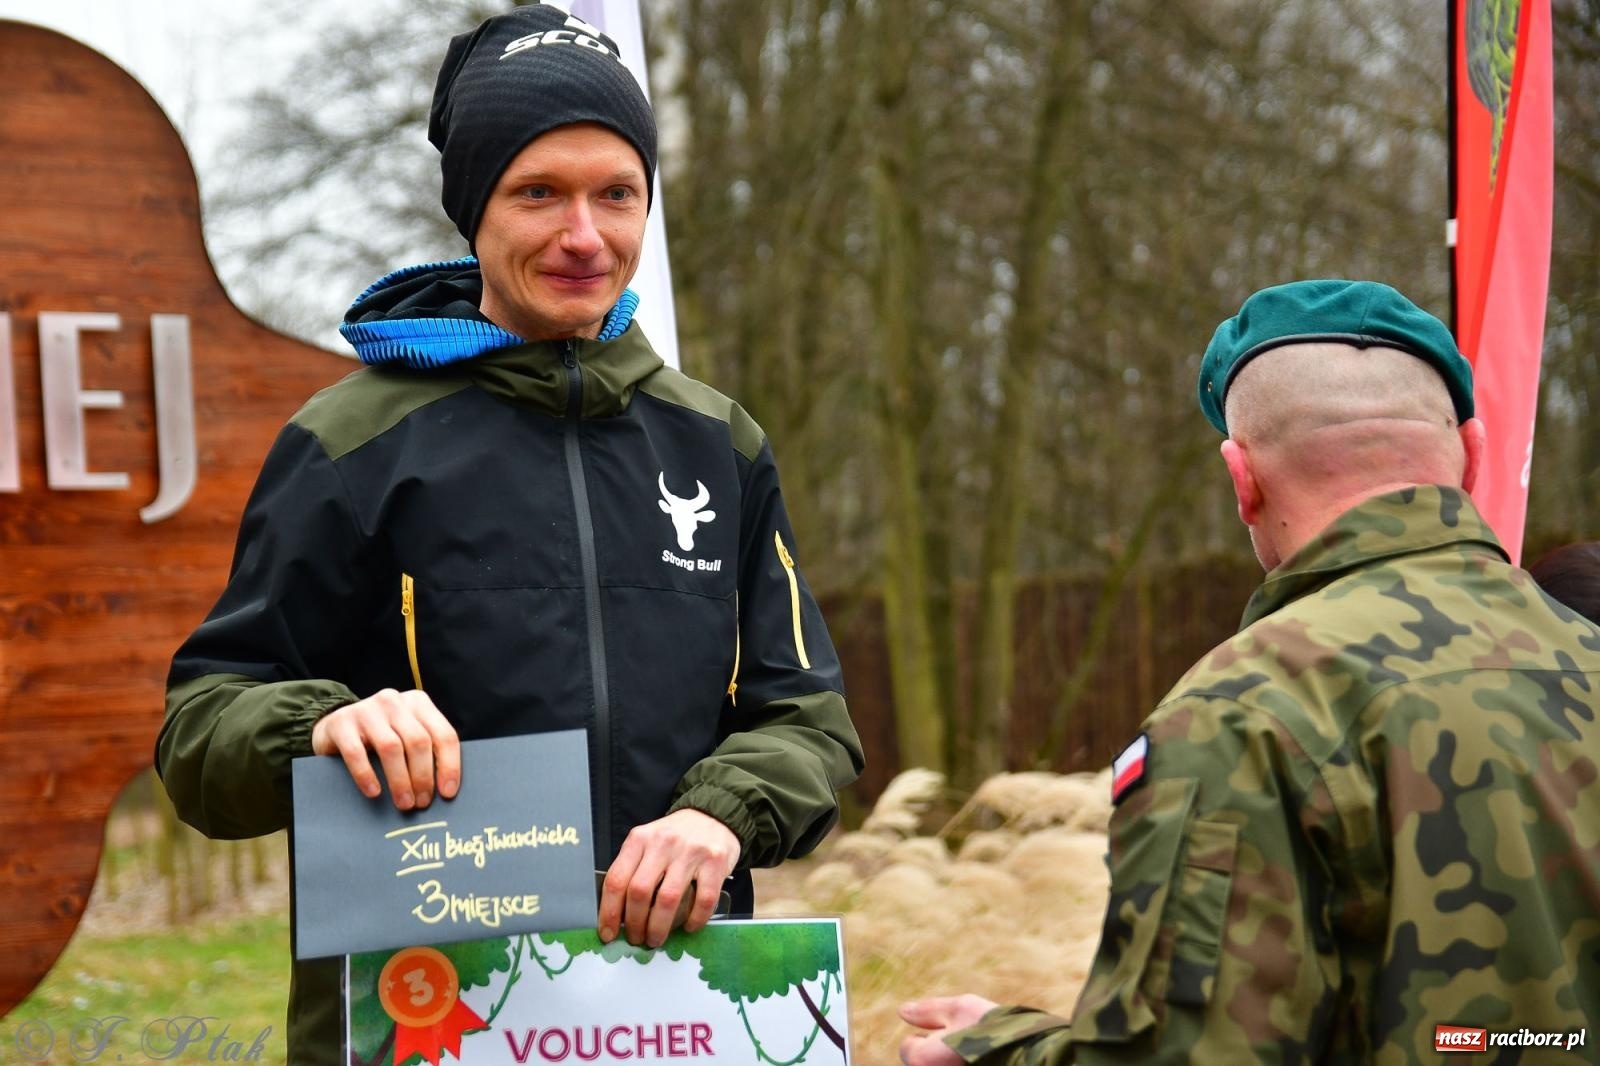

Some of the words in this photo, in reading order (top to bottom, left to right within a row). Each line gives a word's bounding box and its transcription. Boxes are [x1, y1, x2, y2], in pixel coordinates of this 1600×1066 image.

[499, 29, 621, 61] SCO
[661, 549, 695, 572] Strong
[697, 559, 722, 572] Bull
[412, 880, 450, 924] 3
[402, 967, 435, 1004] 3
[503, 1022, 714, 1064] VOUCHER
